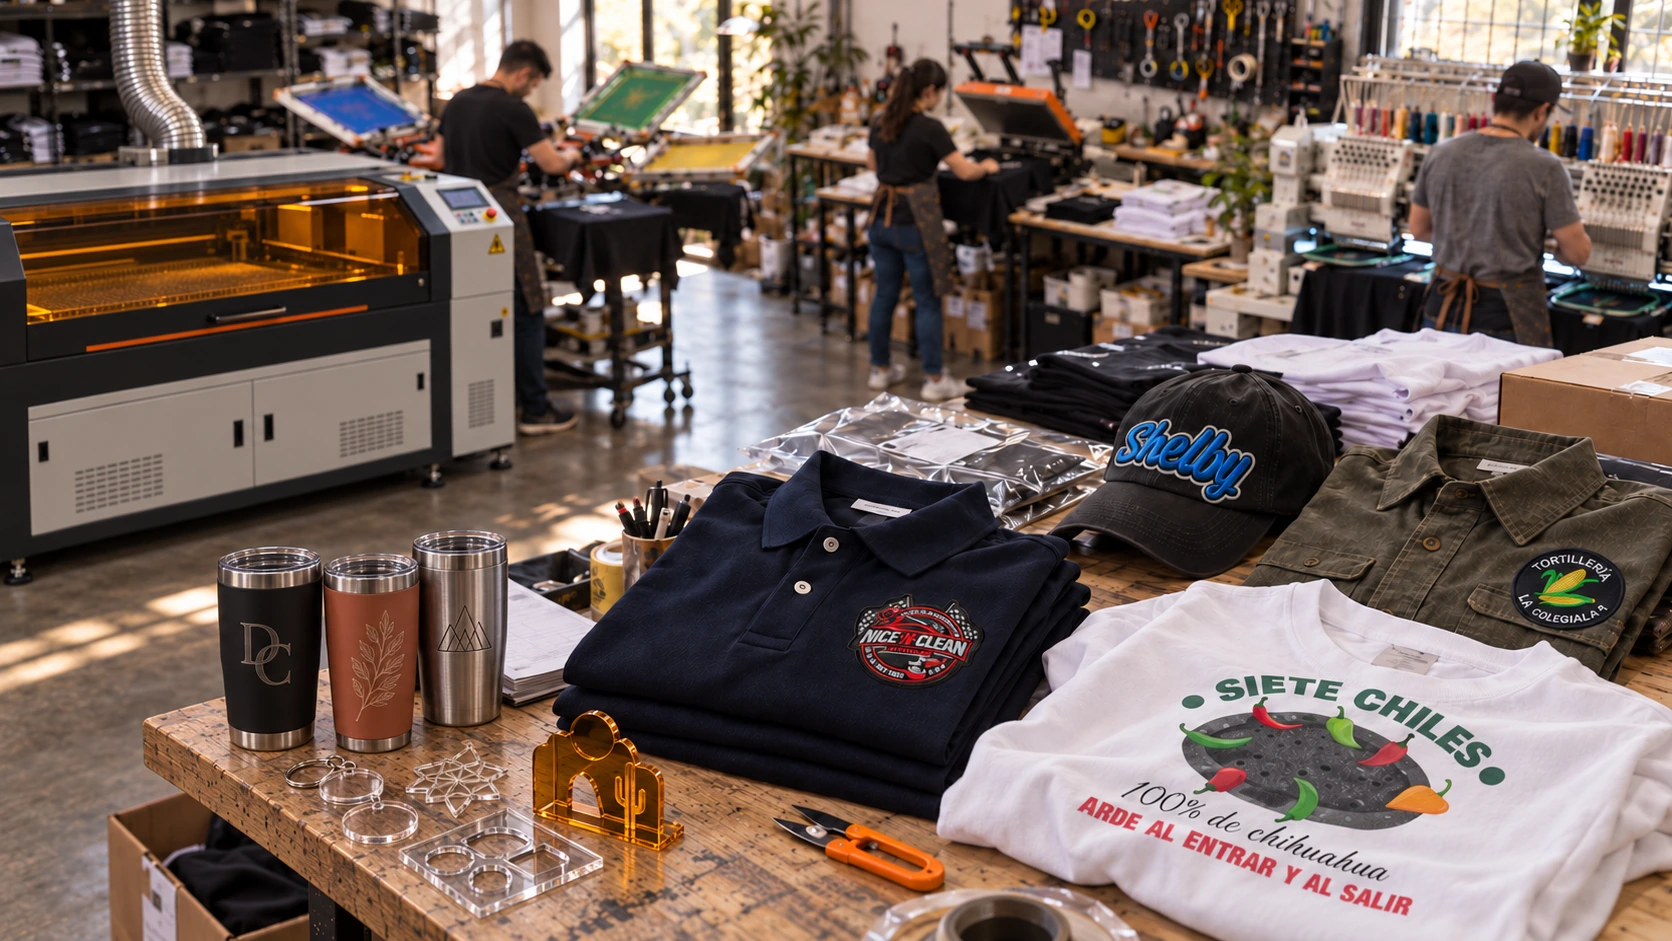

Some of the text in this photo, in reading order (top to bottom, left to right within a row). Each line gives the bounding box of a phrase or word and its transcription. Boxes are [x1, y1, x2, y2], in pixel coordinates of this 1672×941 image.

[1115, 419, 1256, 504] Shelby
[1518, 593, 1534, 609] LA
[1531, 554, 1613, 583] TORTILLERÍA
[859, 628, 902, 644] NICE
[915, 634, 968, 657] CLEAN
[1215, 674, 1493, 768] SIETE CHILES
[1077, 796, 1414, 916] ARDE AL ENTRAR Y AL SALIR
[1121, 781, 1390, 882] 100% de chihuahua
